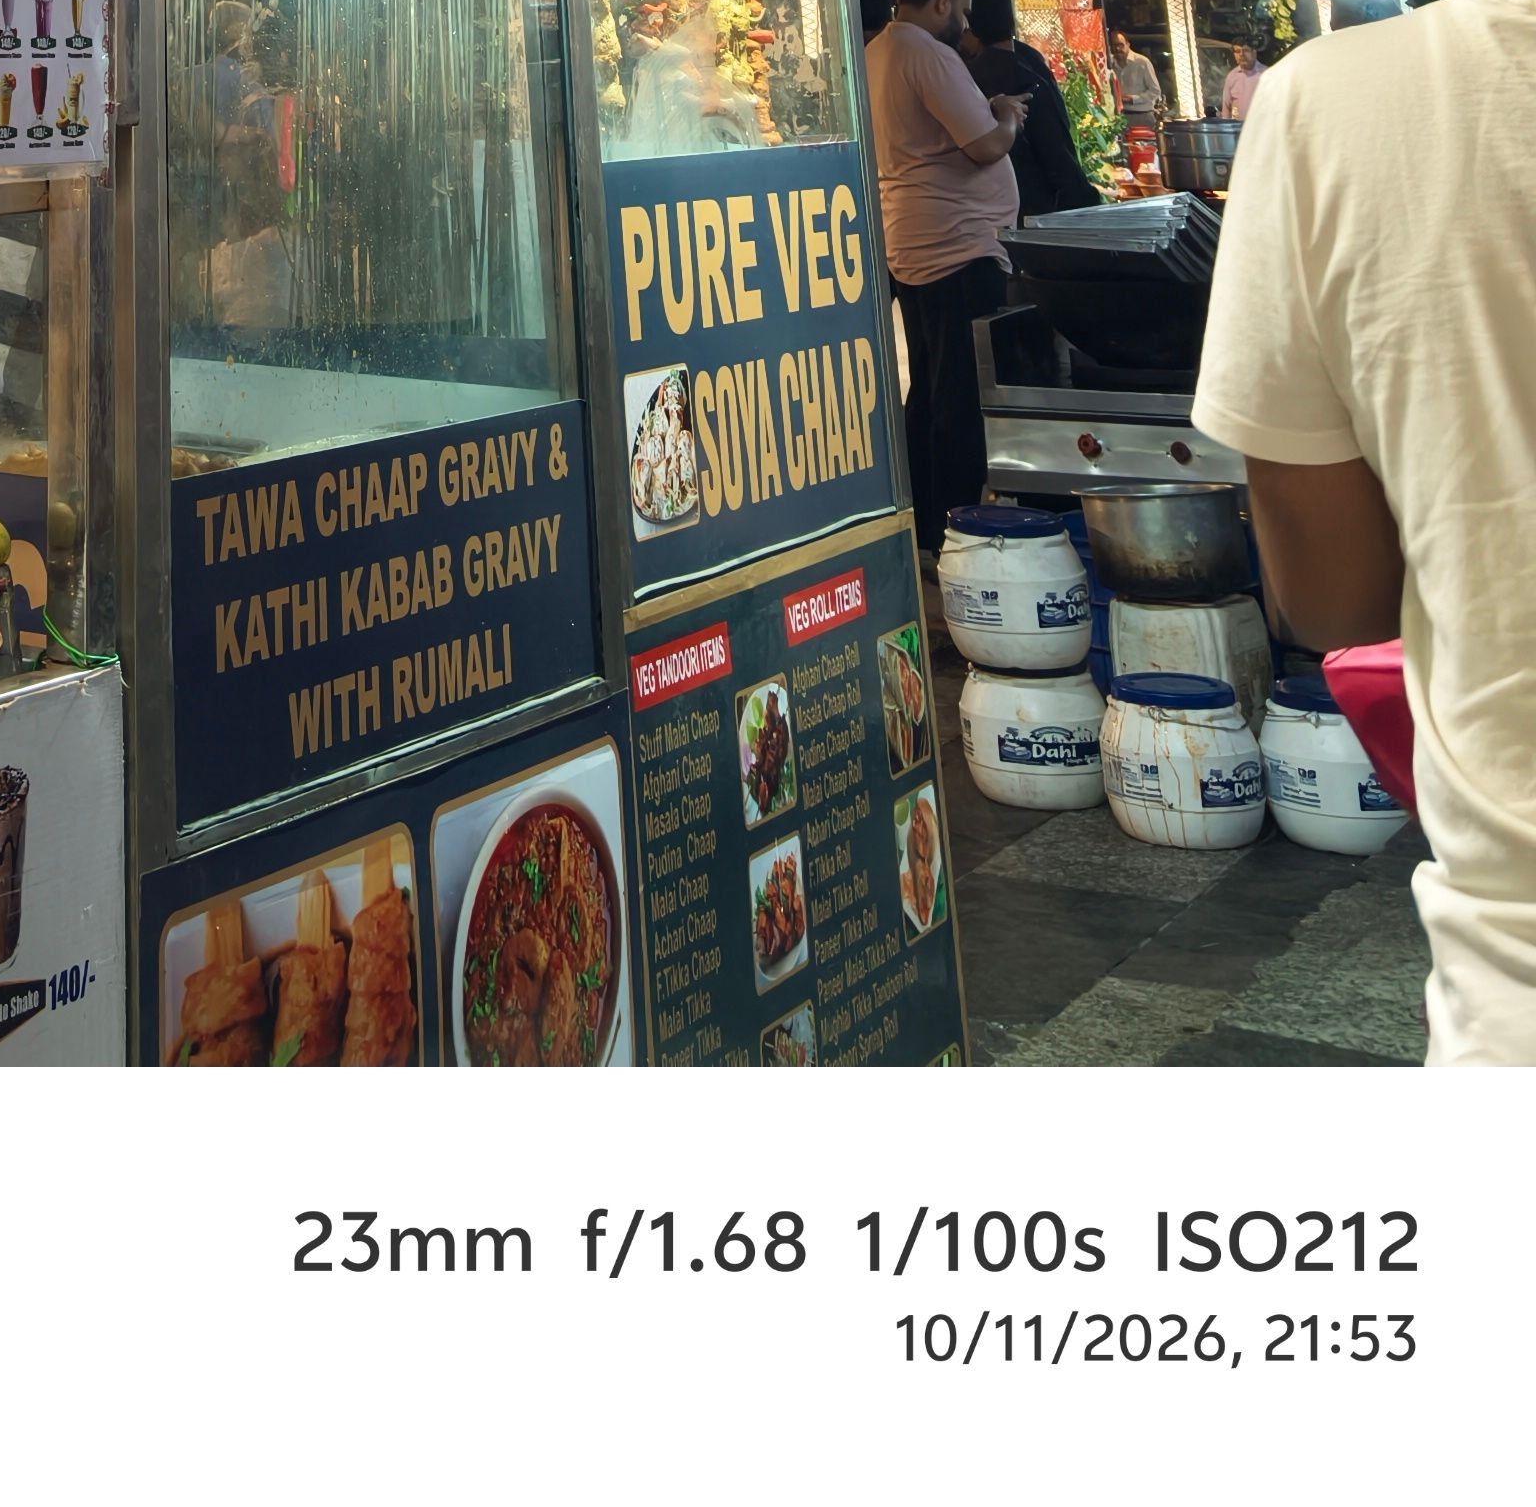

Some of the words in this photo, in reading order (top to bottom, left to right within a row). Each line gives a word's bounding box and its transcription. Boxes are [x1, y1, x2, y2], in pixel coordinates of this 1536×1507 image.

[620, 194, 763, 342] PURE
[766, 184, 864, 313] VEG
[694, 358, 783, 518] SOYA
[778, 337, 877, 492] CHAAP
[196, 480, 305, 566] TAWA
[314, 452, 428, 538] CHAAP
[437, 427, 539, 507] GRAVY
[548, 422, 569, 481] &
[215, 575, 329, 674] KATHI
[339, 544, 454, 636] KABAB
[463, 513, 562, 599] GRAVY
[788, 600, 809, 634] VEG
[810, 589, 834, 627] ROLL
[834, 579, 862, 619] ITEMS
[288, 665, 381, 760] WITH
[392, 623, 513, 724] RUMALI
[635, 664, 655, 698] VEG
[656, 647, 700, 692] TANDOORI
[700, 634, 726, 676] ITEMS
[639, 726, 663, 764] Stuff
[664, 716, 690, 753] Malai
[691, 709, 720, 742] Chaap
[1032, 743, 1077, 759] Dahi
[643, 759, 680, 807] Afghani
[682, 753, 712, 786] Chaap
[645, 802, 680, 844] Masala
[681, 792, 712, 825] Chaap
[648, 844, 683, 883] Pudina
[686, 829, 717, 863] Chaap
[48, 960, 96, 1011] 140/-
